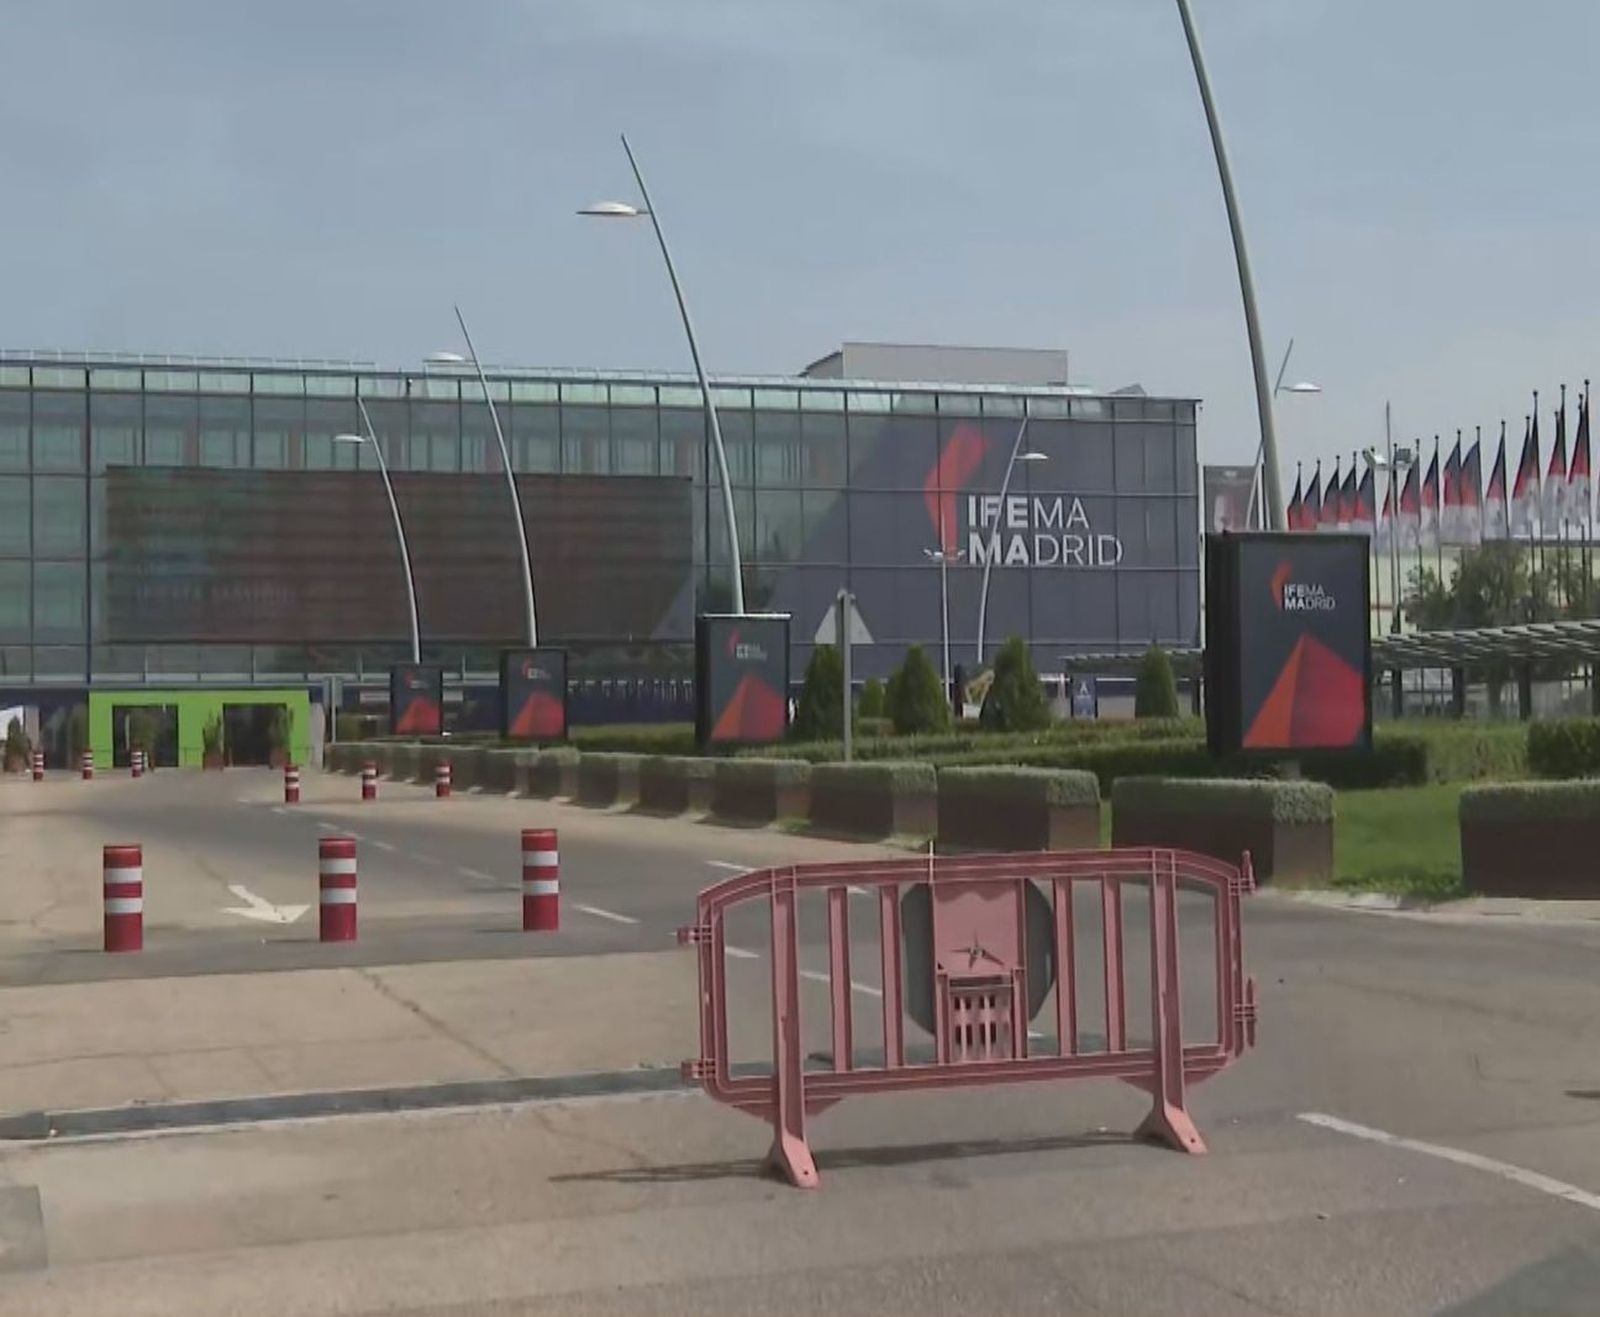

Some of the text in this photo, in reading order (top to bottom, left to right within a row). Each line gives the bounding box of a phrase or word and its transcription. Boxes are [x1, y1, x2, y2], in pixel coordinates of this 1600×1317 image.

[968, 495, 1089, 529] IFEMA
[968, 533, 1123, 566] MADRID
[1284, 583, 1325, 597] IFEMA
[1284, 597, 1336, 610] MADRID
